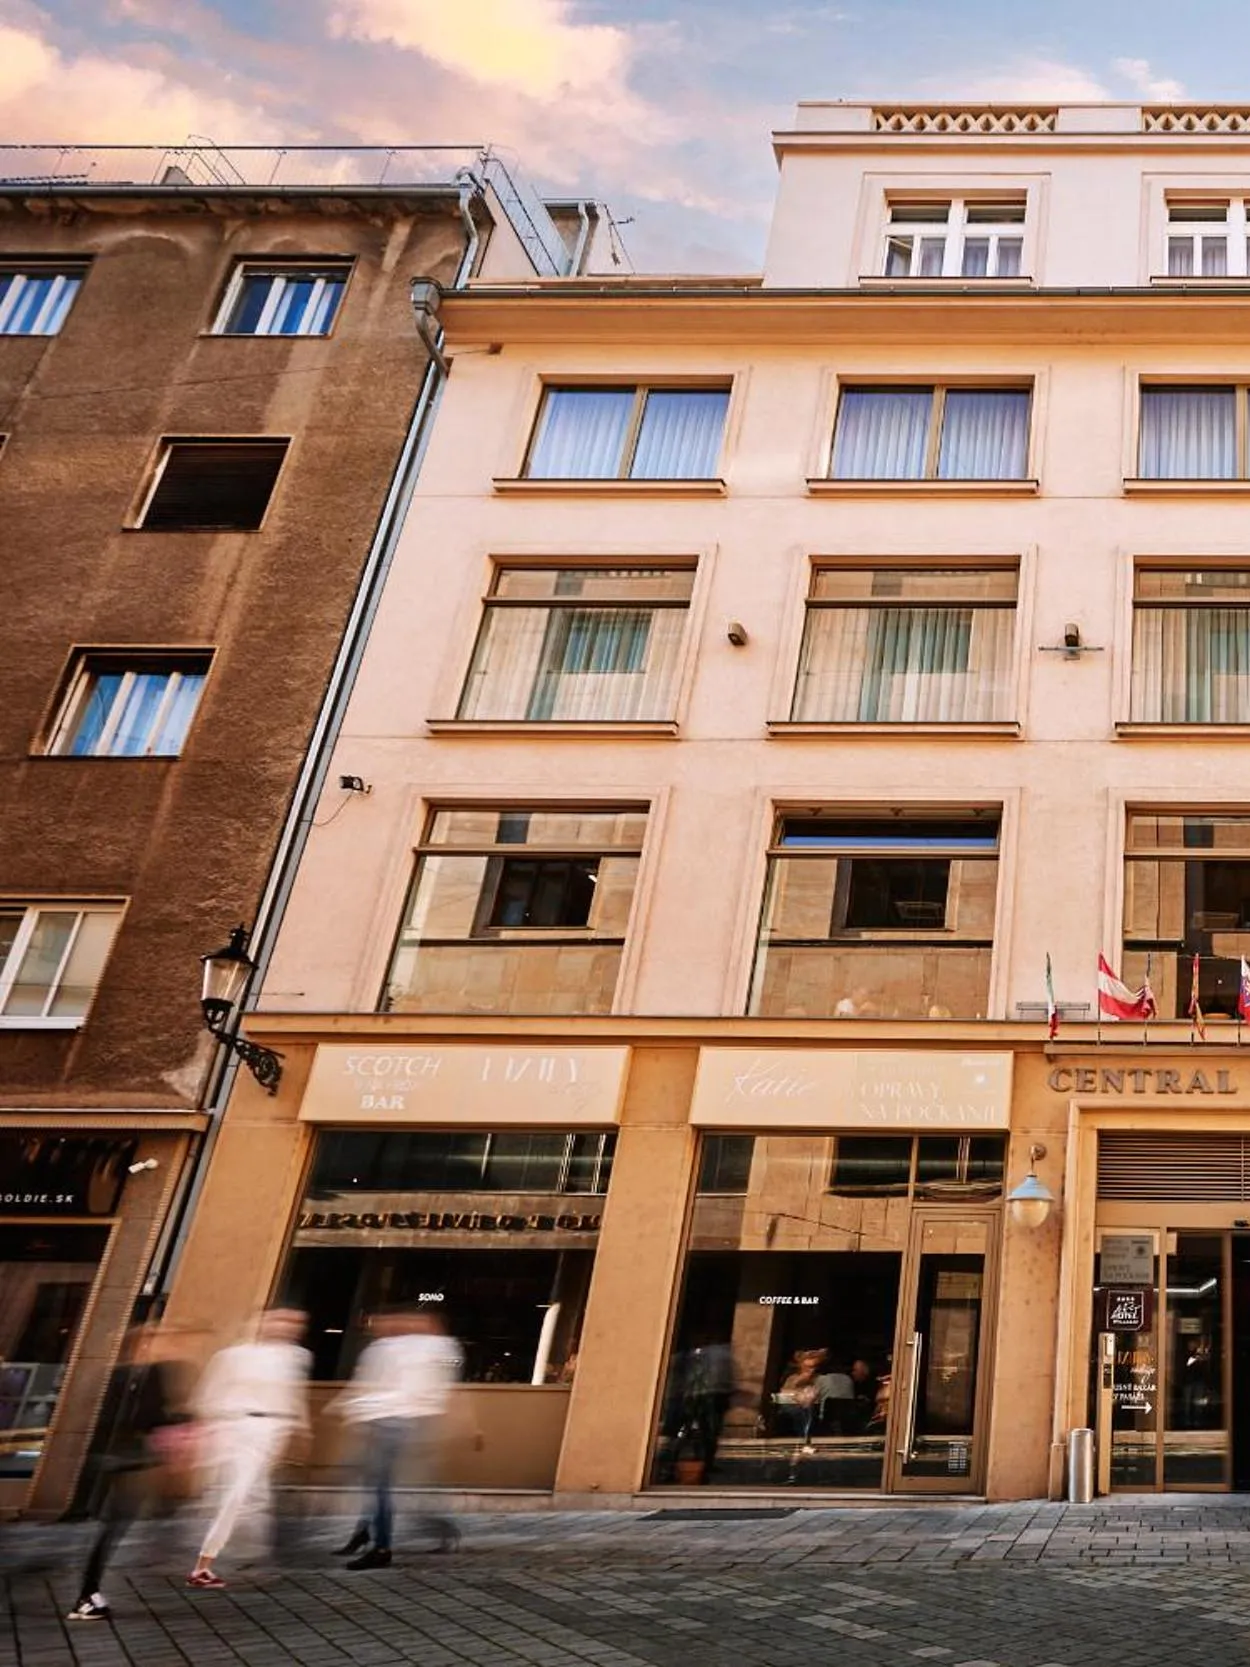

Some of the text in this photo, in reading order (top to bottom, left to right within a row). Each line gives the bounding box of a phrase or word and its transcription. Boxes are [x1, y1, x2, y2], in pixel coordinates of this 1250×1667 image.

[1049, 1068, 1238, 1095] CENTRAL
[360, 1094, 405, 1110] BAR
[0, 1193, 75, 1204] OLDIE.SK
[759, 1296, 792, 1304] COFFEE
[801, 1296, 820, 1304] BAR
